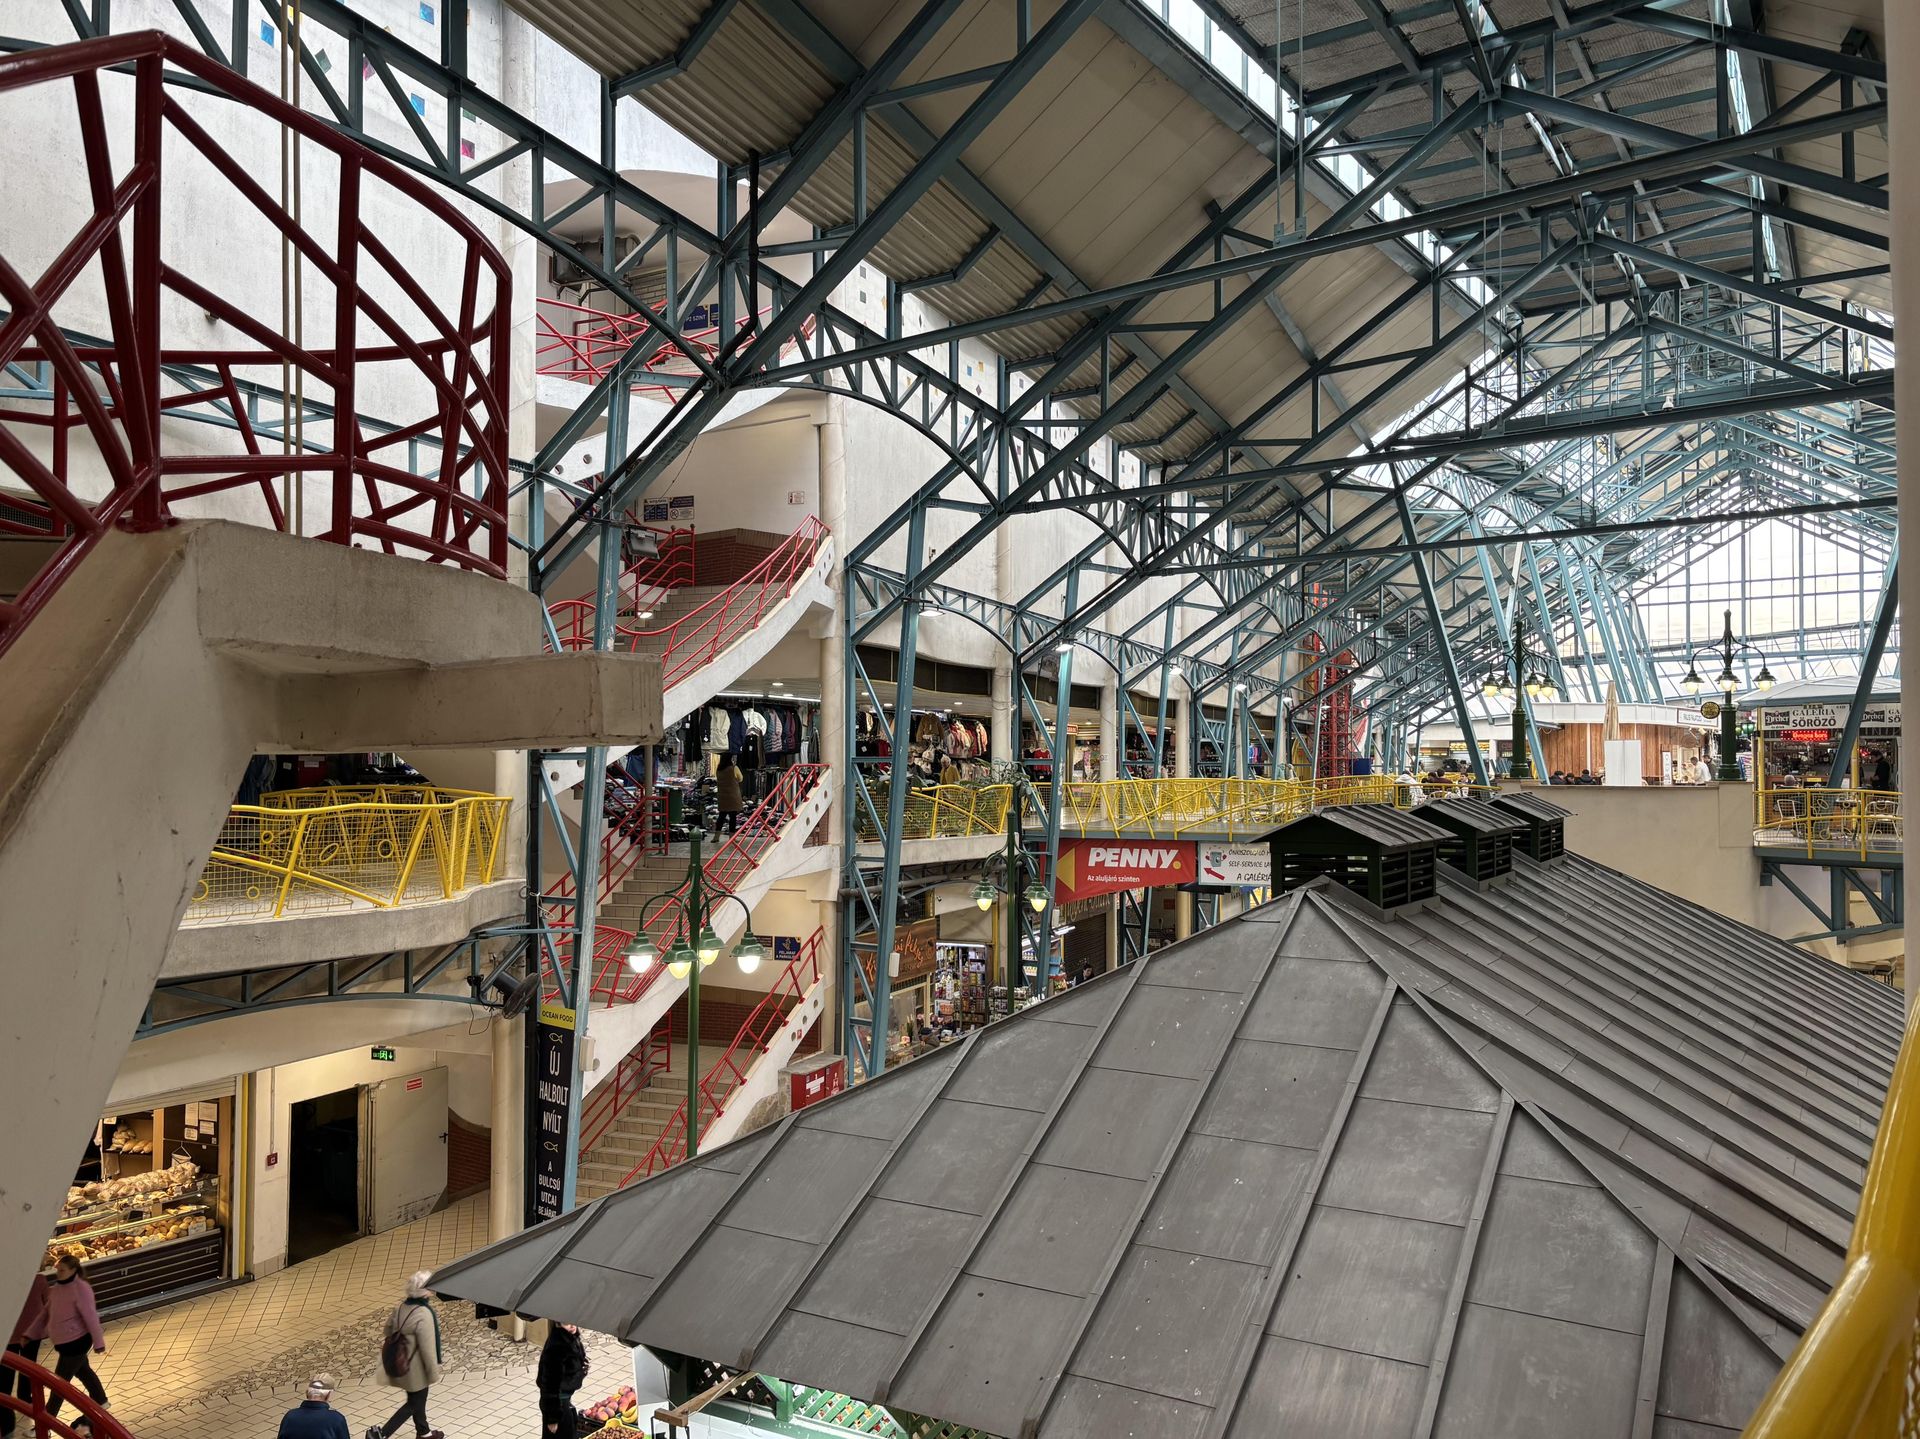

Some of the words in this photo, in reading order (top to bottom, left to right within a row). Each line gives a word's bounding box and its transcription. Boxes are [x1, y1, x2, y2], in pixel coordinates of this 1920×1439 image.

[1765, 714, 1789, 723] Dreher
[1087, 874, 1095, 882] Az
[1095, 874, 1118, 884] aluljáró
[1117, 875, 1140, 883] szinten
[1236, 873, 1242, 881] A
[541, 1010, 559, 1020] OCEAN
[559, 1014, 574, 1023] FOOD
[549, 1046, 561, 1076] ÚJ
[539, 1080, 569, 1106] HALBOLT
[542, 1109, 562, 1135] NYÍLT
[547, 1160, 553, 1173] A
[538, 1173, 561, 1191] BULCSÚ
[540, 1191, 557, 1206] UTCAI
